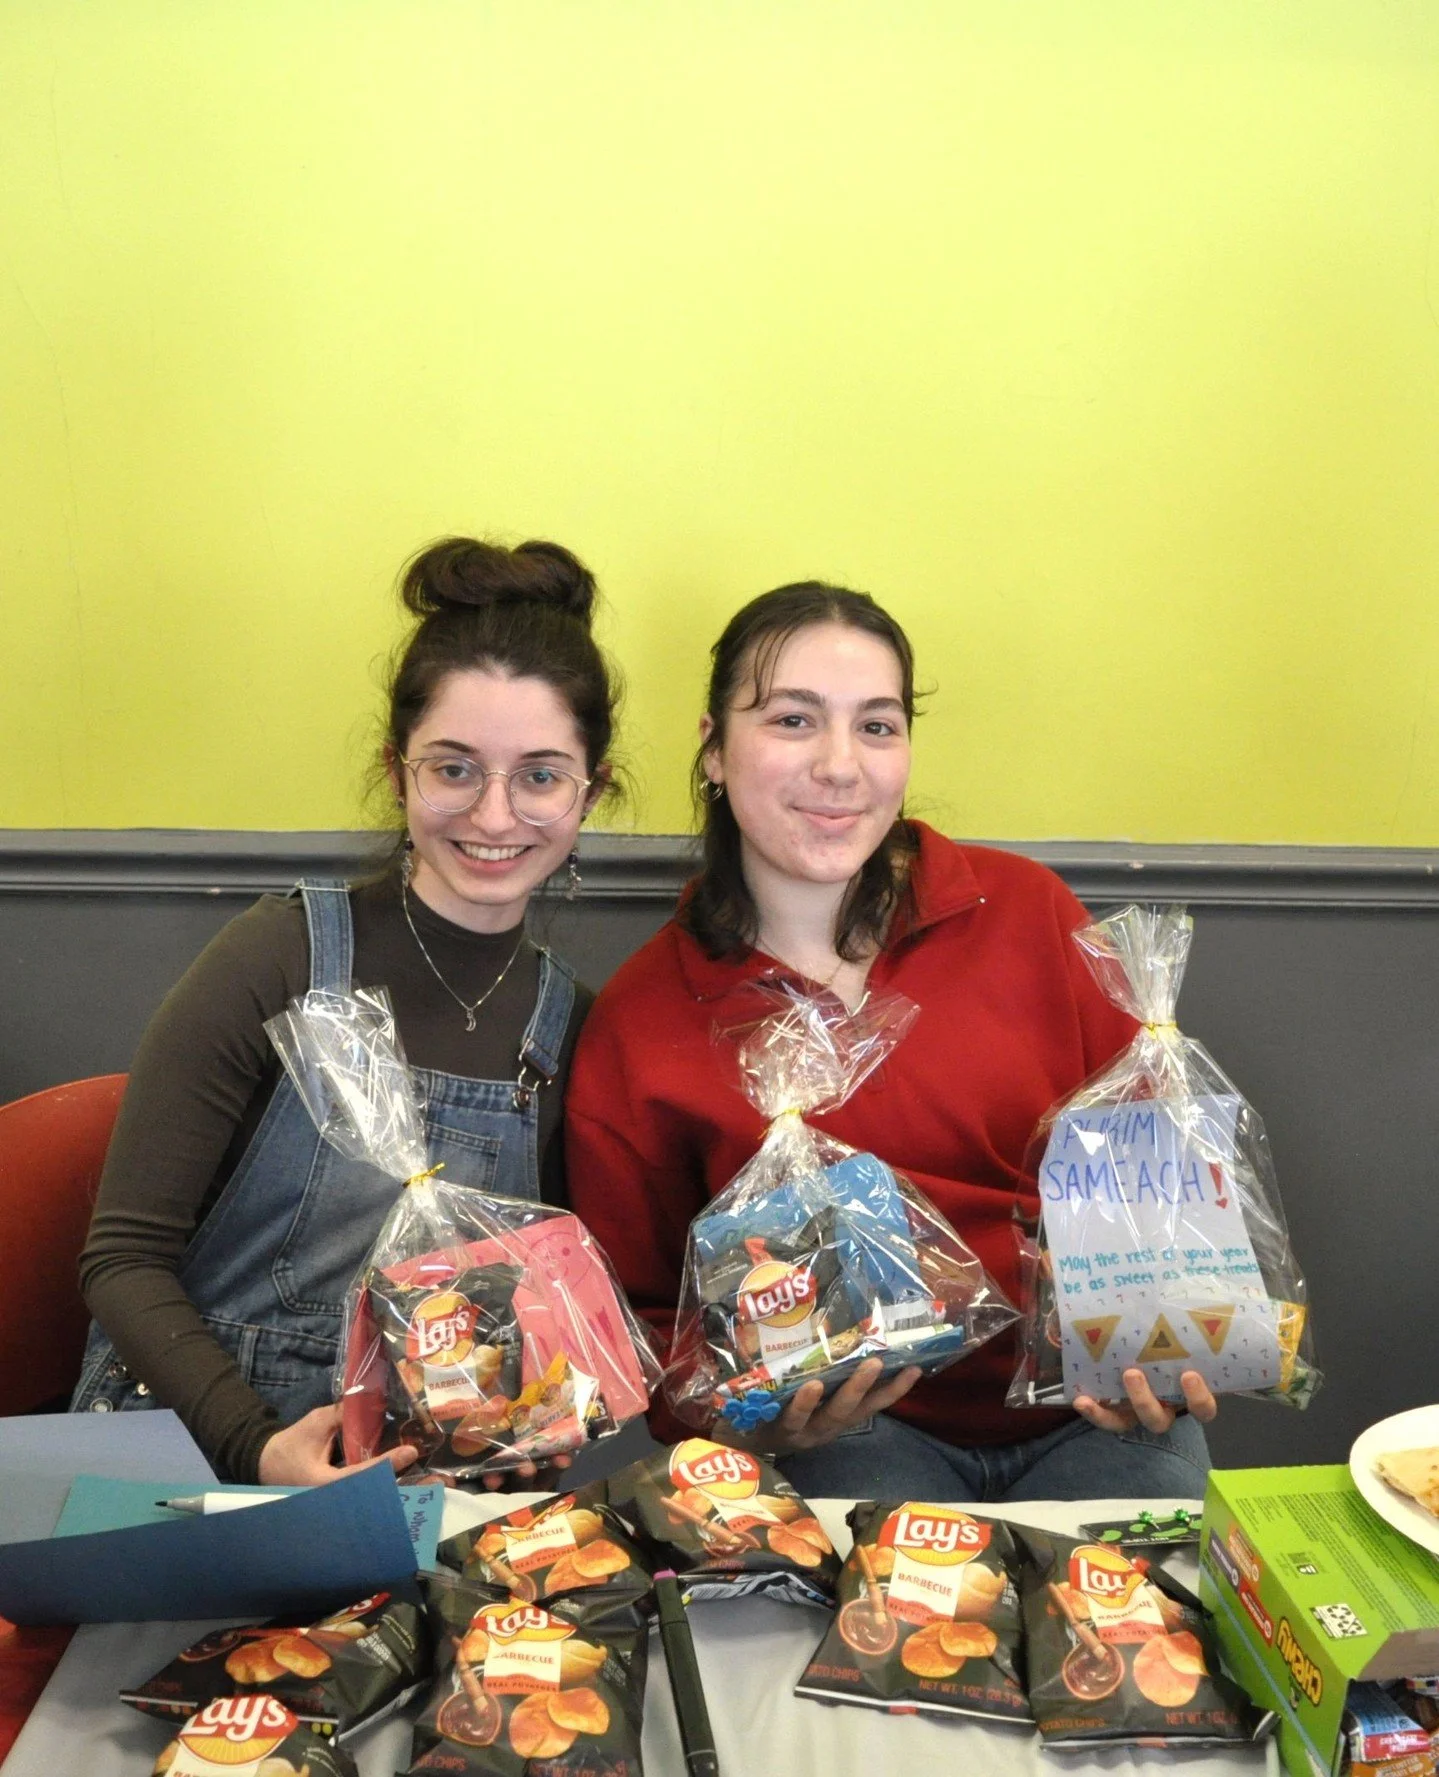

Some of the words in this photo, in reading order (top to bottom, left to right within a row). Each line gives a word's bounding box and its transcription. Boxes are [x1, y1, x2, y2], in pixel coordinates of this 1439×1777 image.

[1058, 1254, 1092, 1276] May
[1094, 1252, 1120, 1268] the
[1125, 1246, 1156, 1264] rest
[1183, 1248, 1213, 1266] your
[1220, 1247, 1249, 1263] year
[744, 1270, 811, 1323] Lay's
[1061, 1279, 1082, 1294] be
[1088, 1276, 1106, 1291] as
[1113, 1271, 1155, 1288] sweet
[1162, 1269, 1180, 1281] as
[415, 1305, 471, 1358] Lay's
[678, 1449, 753, 1485] Lay's
[417, 1489, 434, 1505] To
[893, 1510, 981, 1553] Lay's
[897, 1571, 954, 1597] BARBECUE
